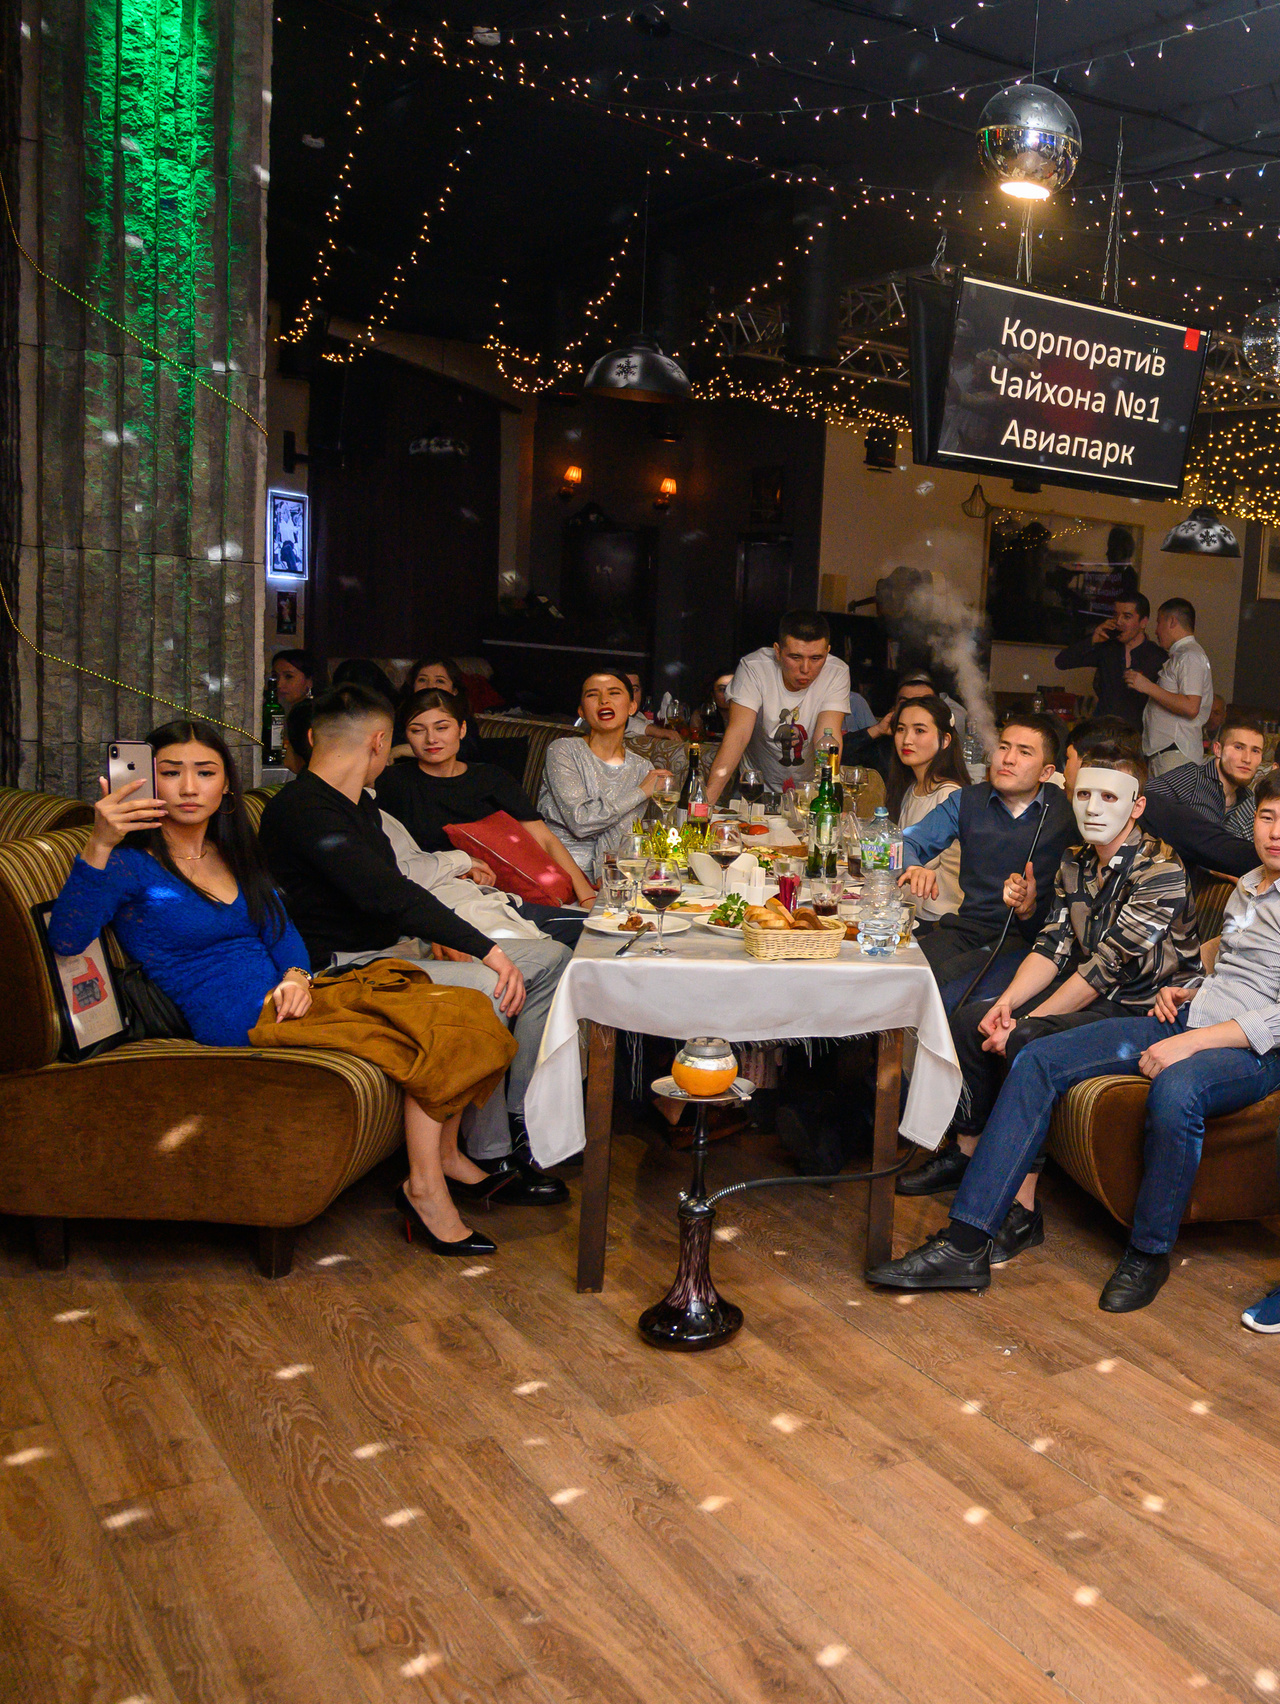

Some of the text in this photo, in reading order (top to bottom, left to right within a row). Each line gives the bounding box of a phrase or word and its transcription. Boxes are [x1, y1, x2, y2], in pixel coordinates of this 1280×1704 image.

[1001, 317, 1166, 377] Корпоратив
[990, 365, 1160, 423] Чайхона №1
[1001, 419, 1136, 468] Авиапарк
